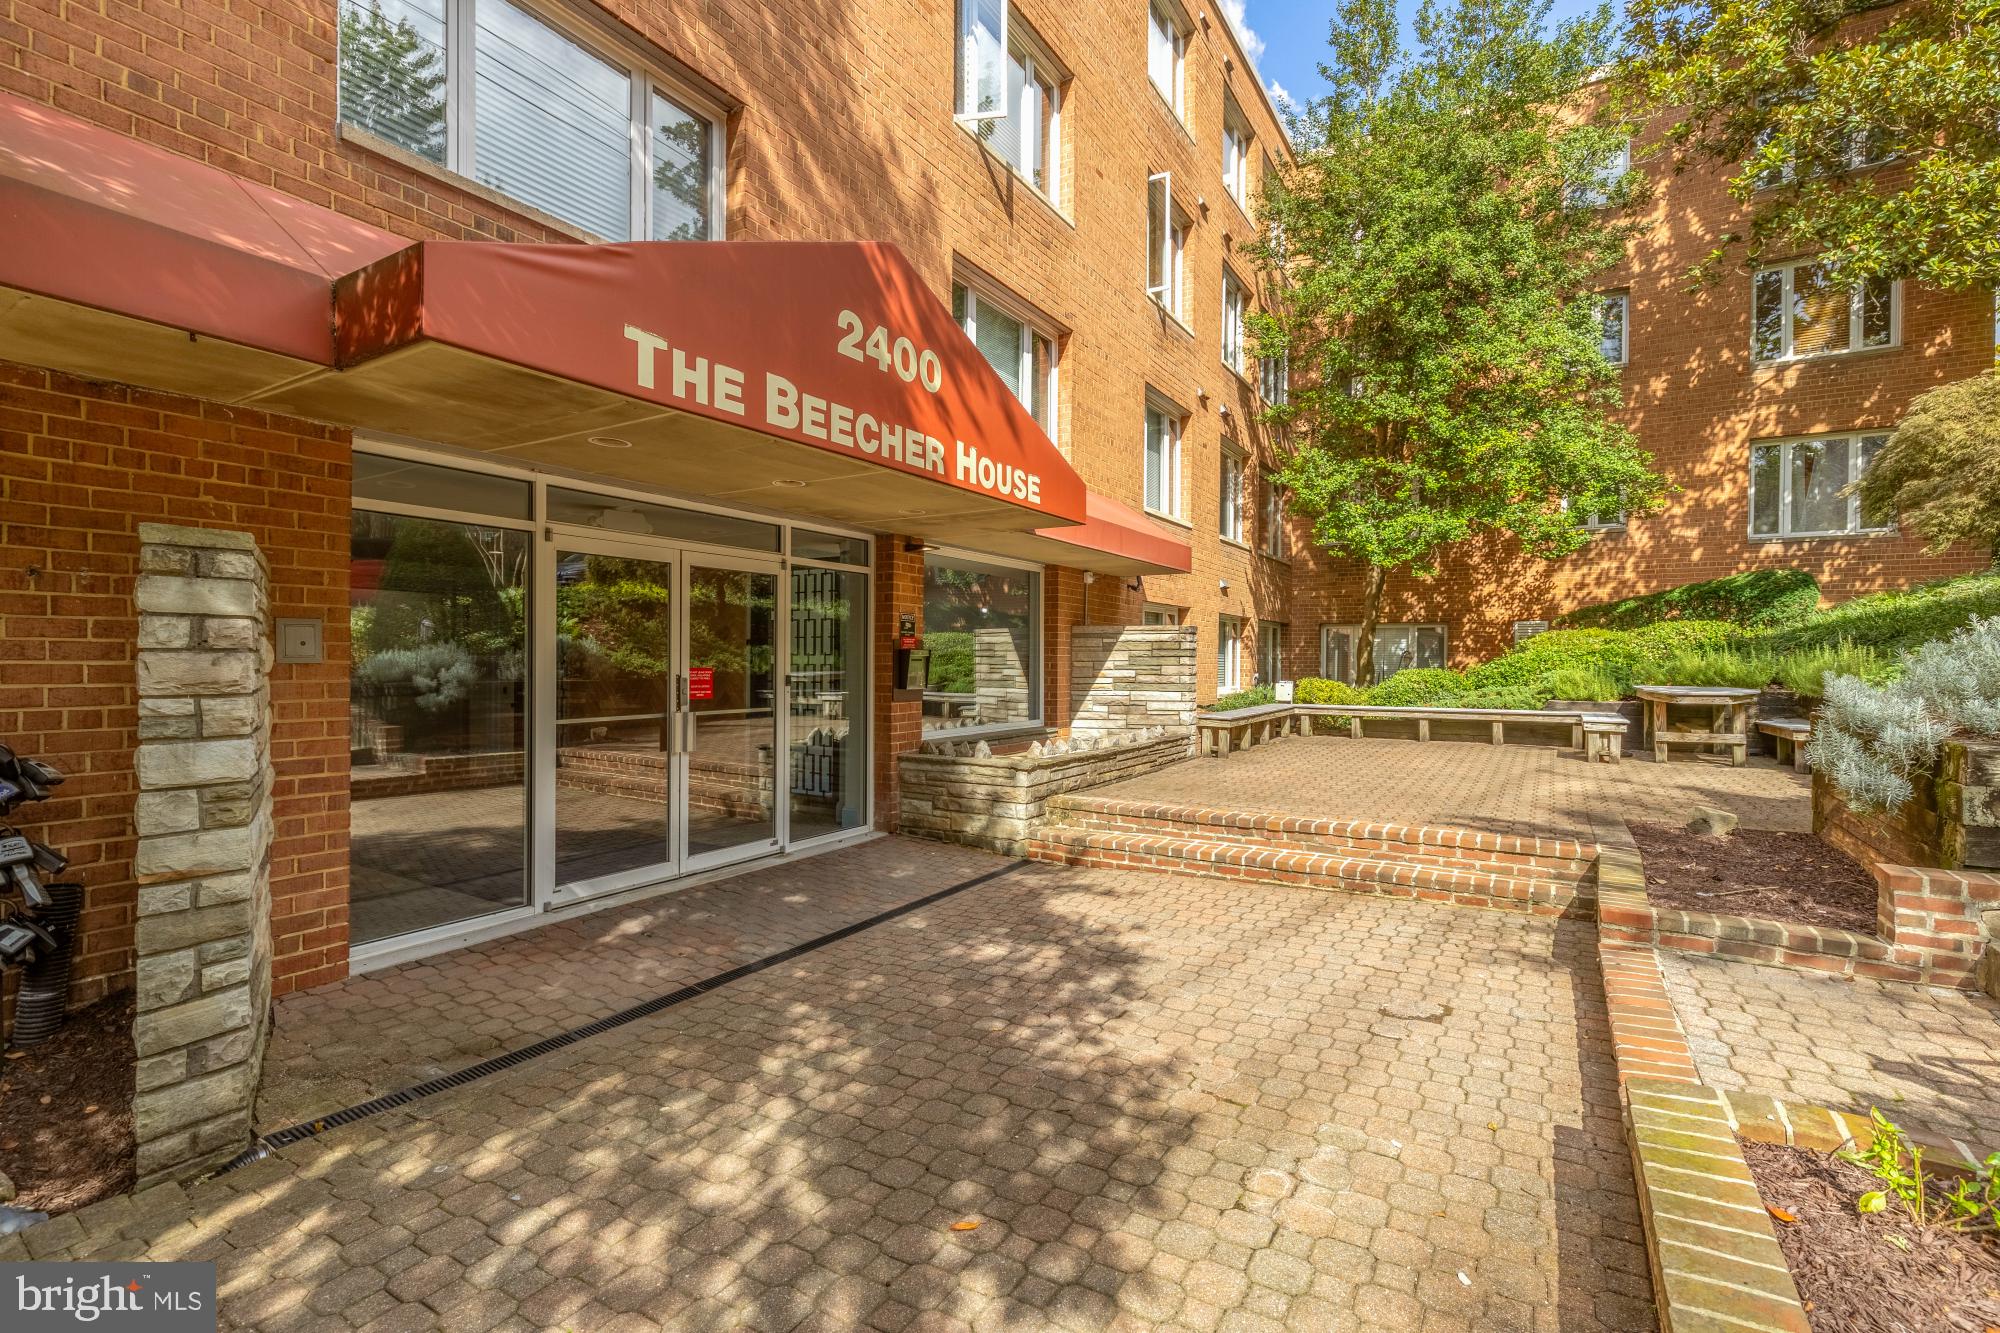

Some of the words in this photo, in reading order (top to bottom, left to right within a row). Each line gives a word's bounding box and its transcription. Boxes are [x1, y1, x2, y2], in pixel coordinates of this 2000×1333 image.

[624, 323, 745, 416] THE
[766, 372, 945, 475] BEECHER
[956, 440, 1041, 504] HOUSE
[837, 309, 942, 393] 2400
